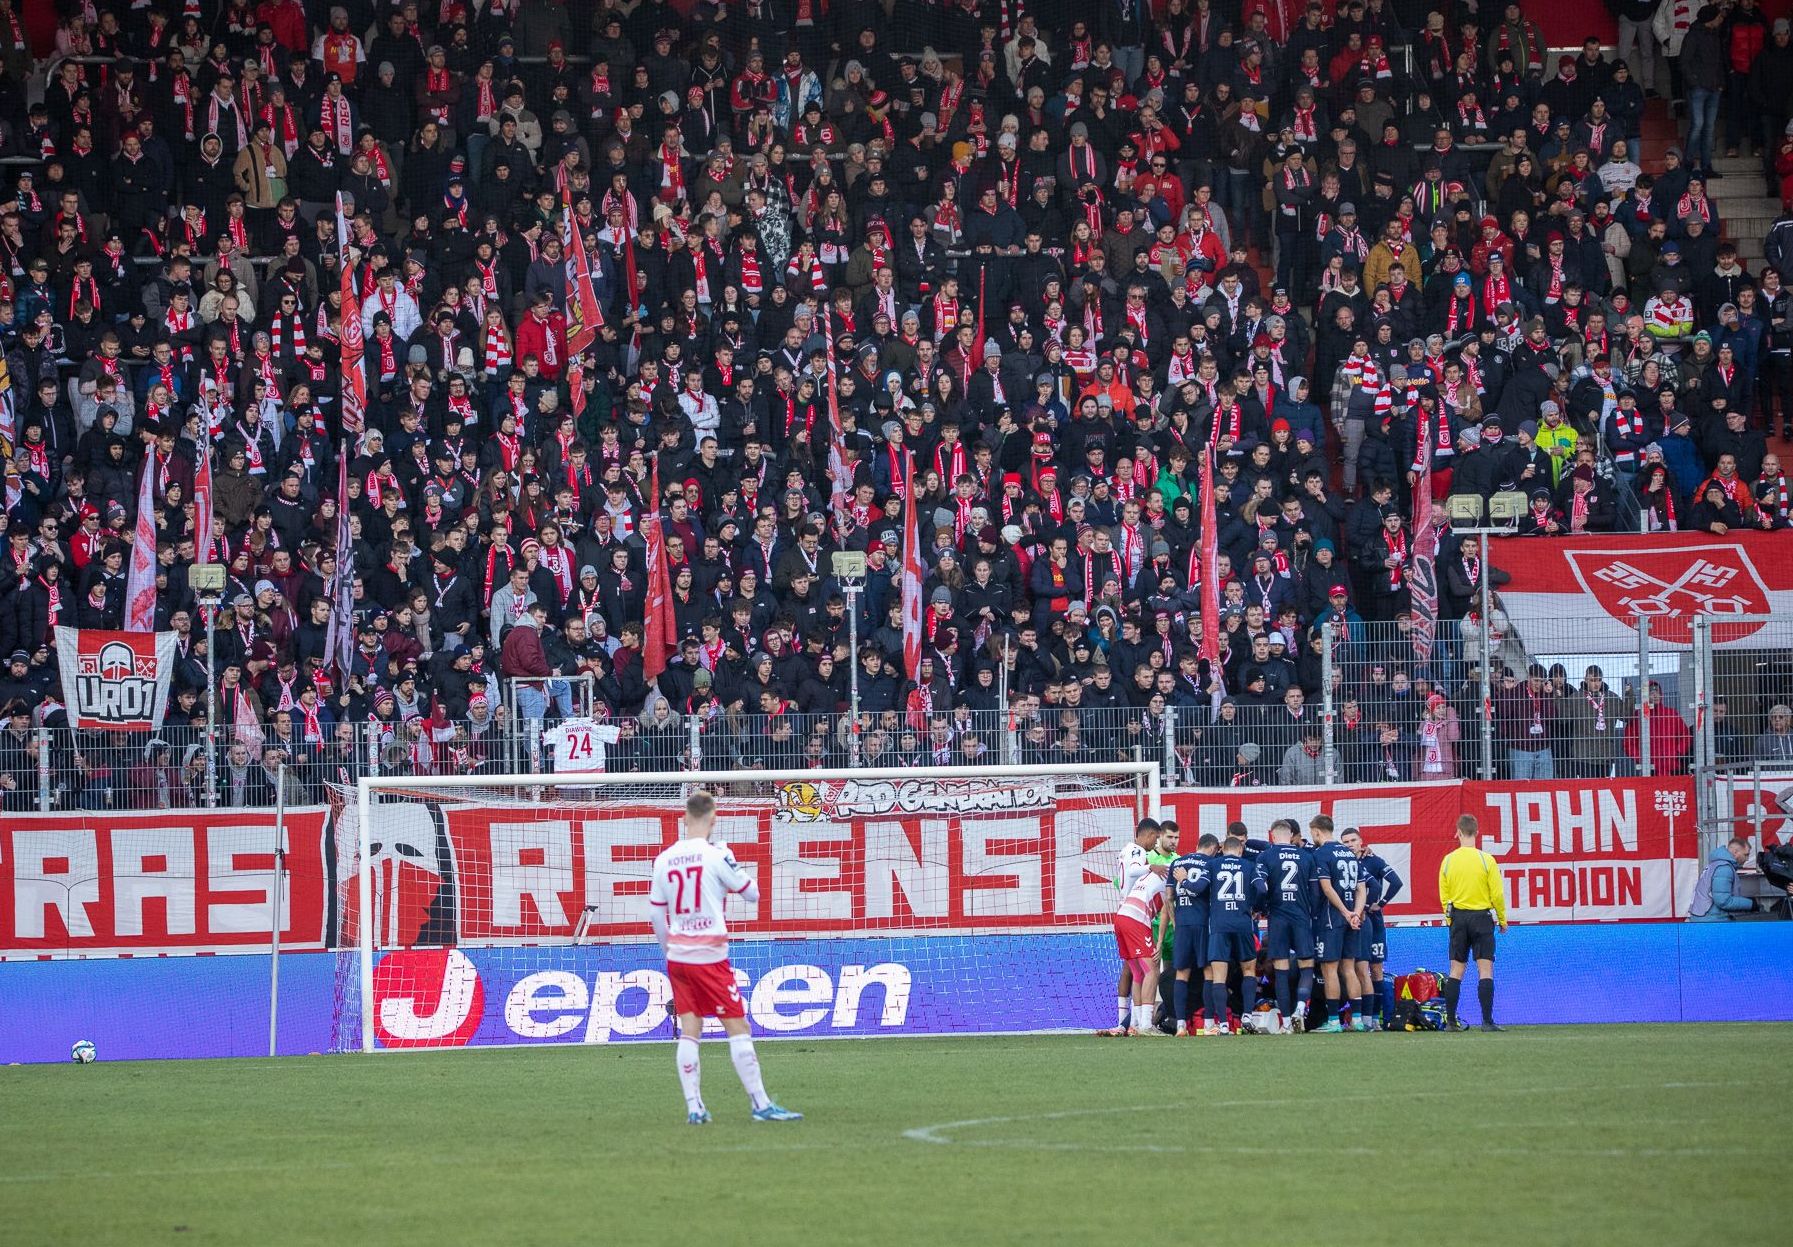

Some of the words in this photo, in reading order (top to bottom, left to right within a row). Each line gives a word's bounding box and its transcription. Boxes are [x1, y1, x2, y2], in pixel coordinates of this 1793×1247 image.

[567, 732, 592, 759] 24
[1481, 789, 1638, 856] JAHN
[1221, 863, 1242, 871] Najar
[1279, 852, 1301, 860] Dietz
[0, 826, 290, 938] RAS
[1216, 870, 1246, 901] 21
[1280, 860, 1299, 891] 2
[1336, 859, 1358, 890] 39
[1500, 866, 1642, 909] TADION
[667, 865, 703, 915] 27
[1179, 896, 1193, 907] ETL
[1282, 891, 1296, 902] ETL
[1225, 901, 1239, 911] ETL
[1371, 942, 1385, 957] 37
